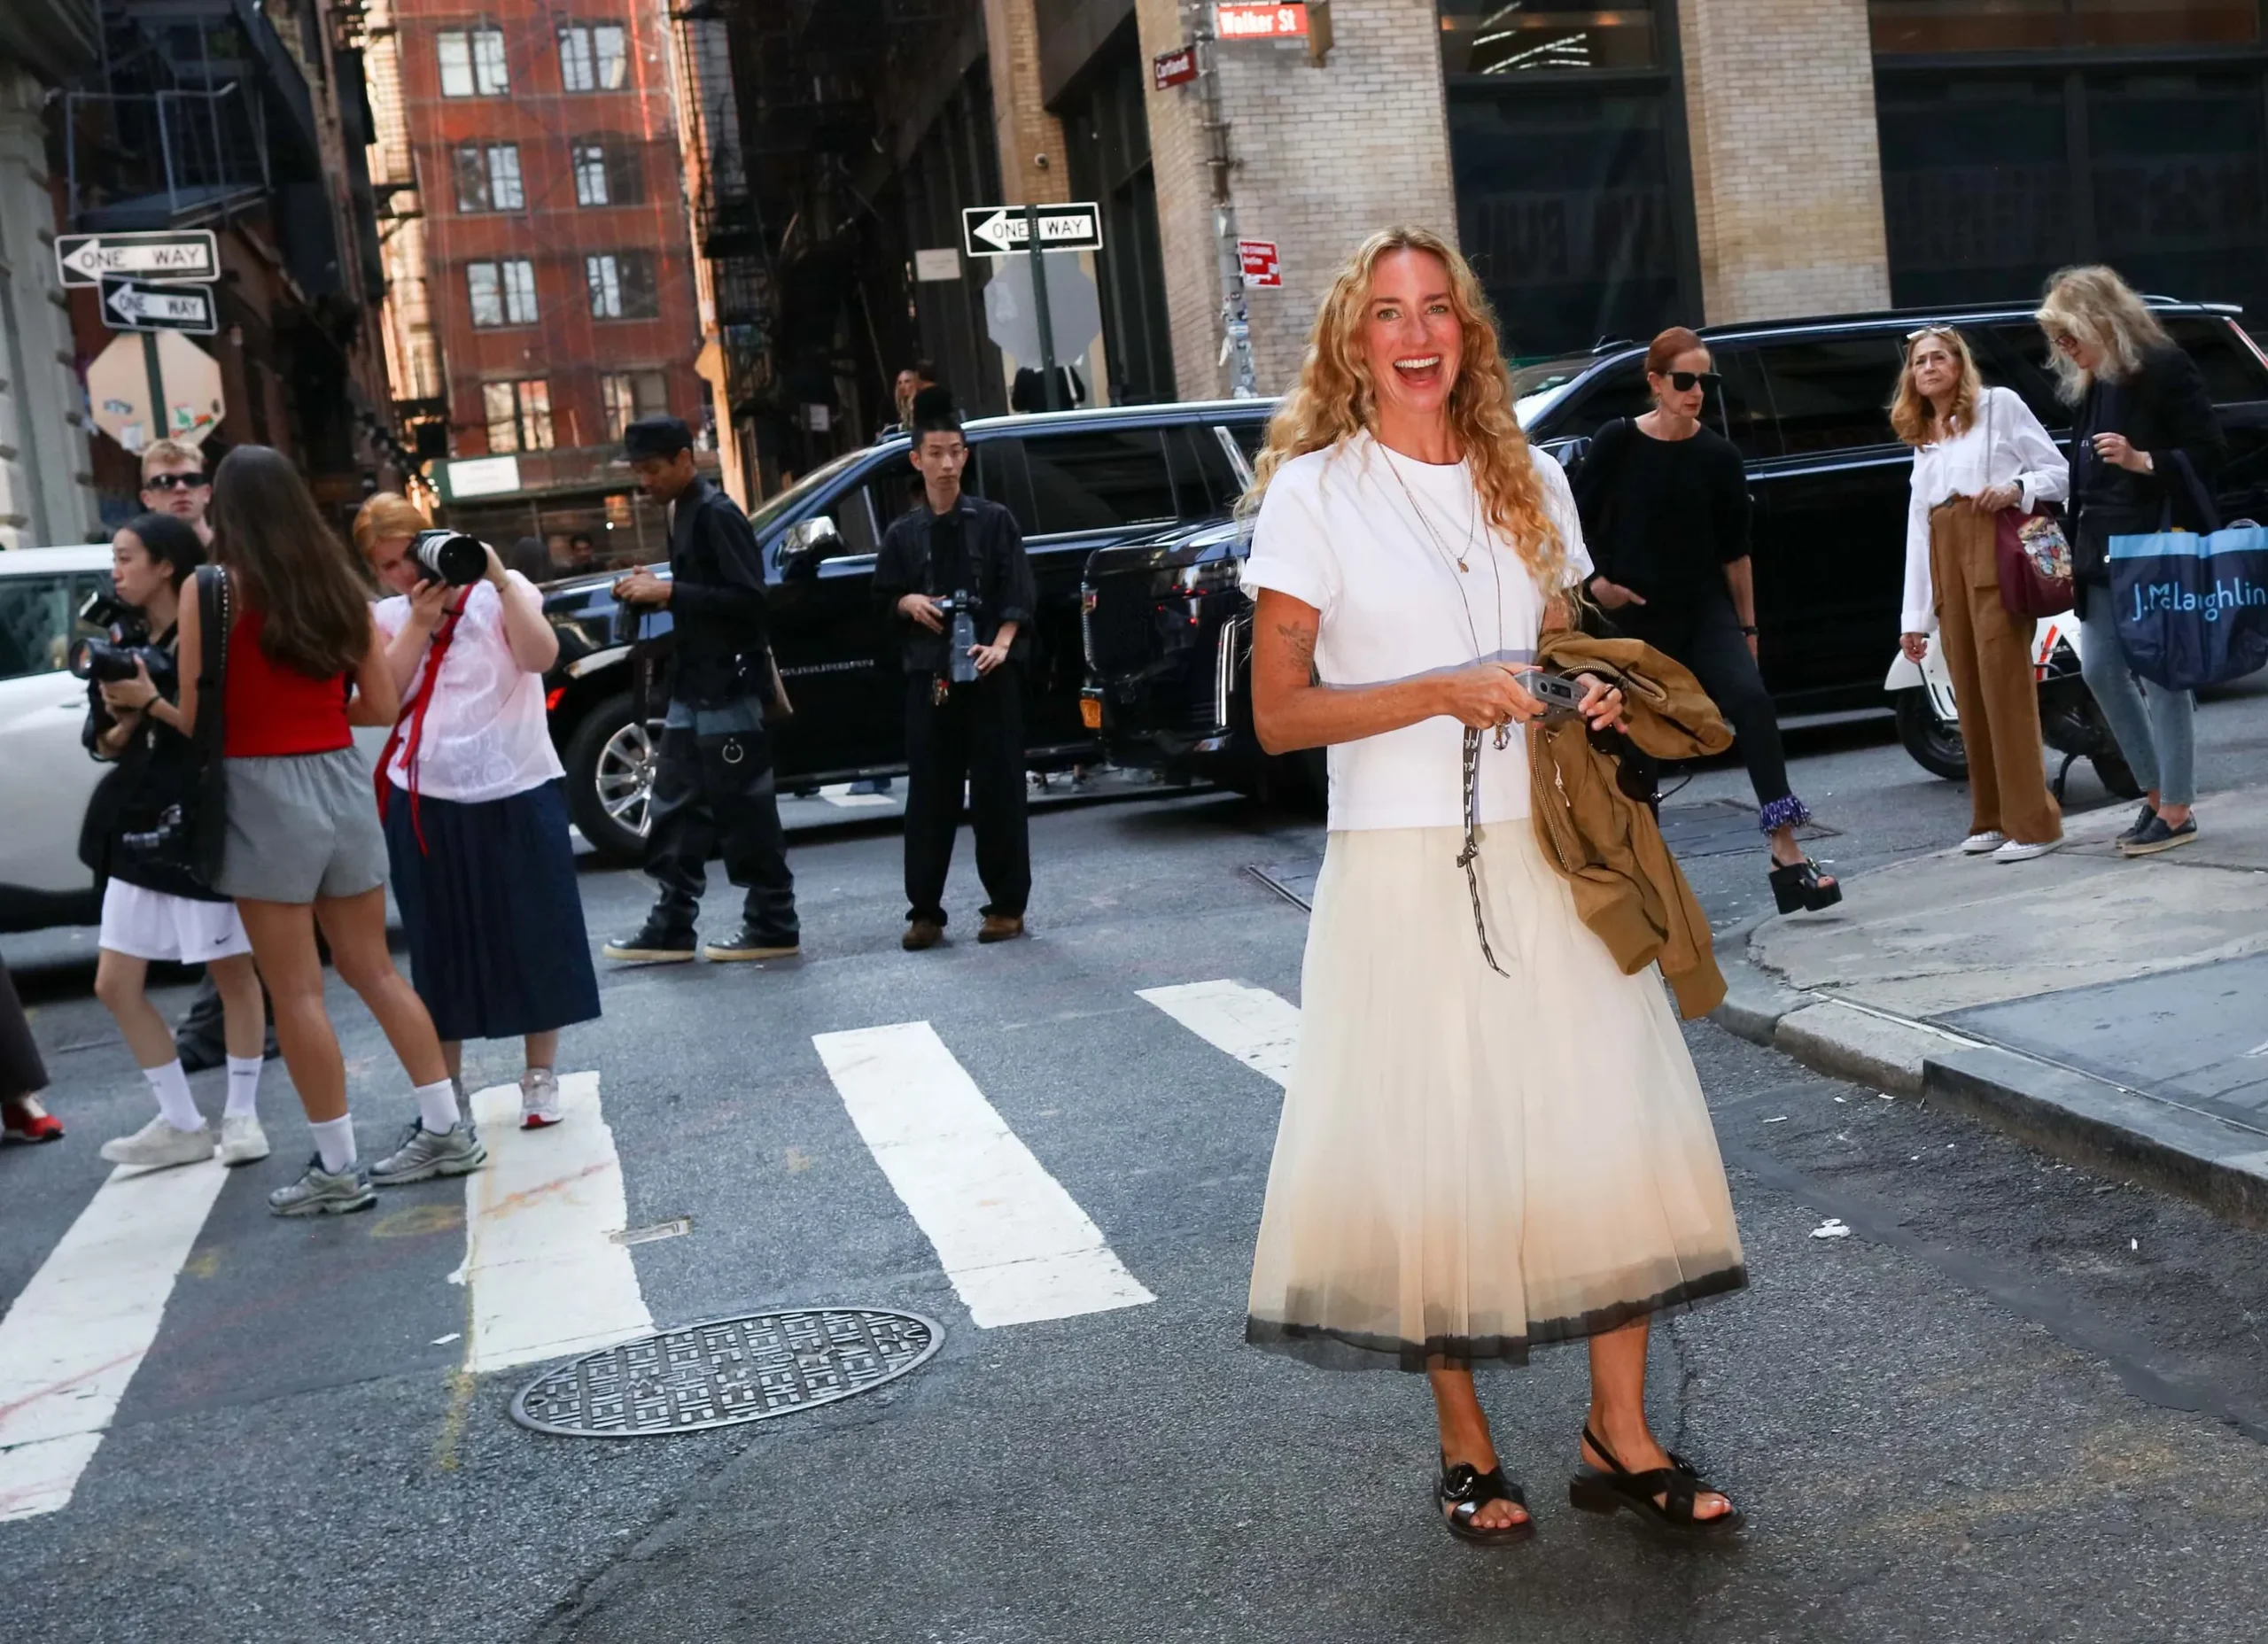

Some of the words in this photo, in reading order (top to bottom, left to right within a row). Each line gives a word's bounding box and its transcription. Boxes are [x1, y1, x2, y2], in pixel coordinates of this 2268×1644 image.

[1220, 11, 1274, 34] Walker
[1278, 8, 1297, 32] St
[992, 221, 1030, 238] ONE
[1046, 219, 1083, 236] WAY
[81, 250, 126, 268] ONE
[151, 247, 198, 266] WAY
[118, 293, 146, 314] ONE
[168, 300, 198, 315] WAY
